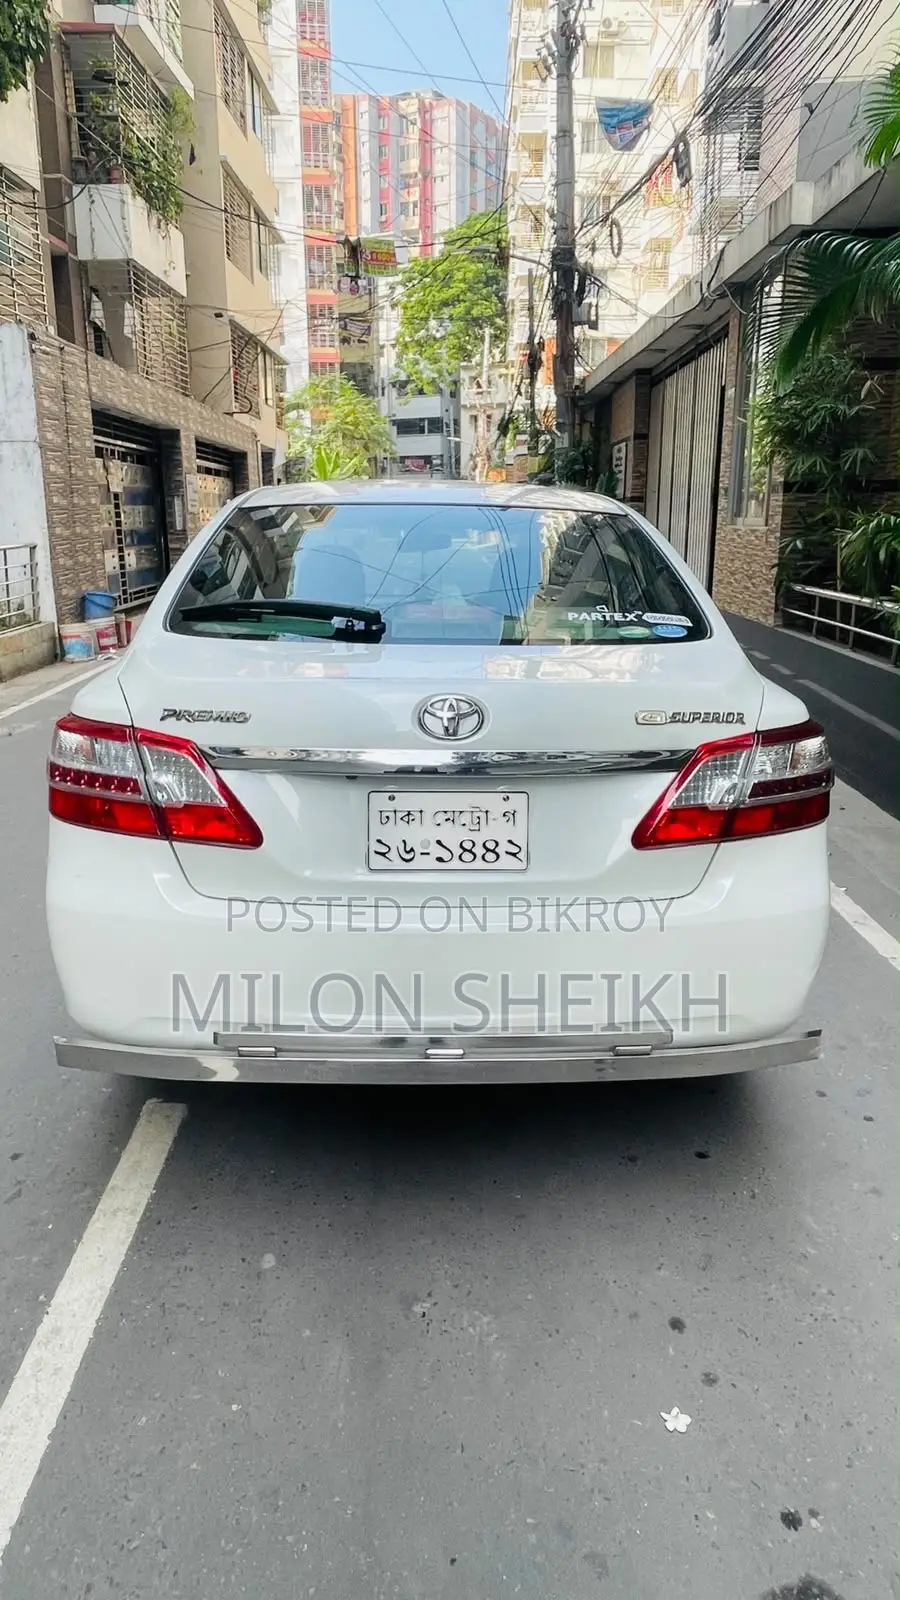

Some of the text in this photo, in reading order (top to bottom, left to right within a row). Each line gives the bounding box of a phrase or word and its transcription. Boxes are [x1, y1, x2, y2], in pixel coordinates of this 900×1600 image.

[567, 612, 638, 621] PARTEX
[160, 708, 252, 723] PREMIO
[667, 711, 746, 725] SUPERIOR
[378, 809, 424, 826] ঢাকা
[373, 838, 524, 863] ২৬-১৪৪২
